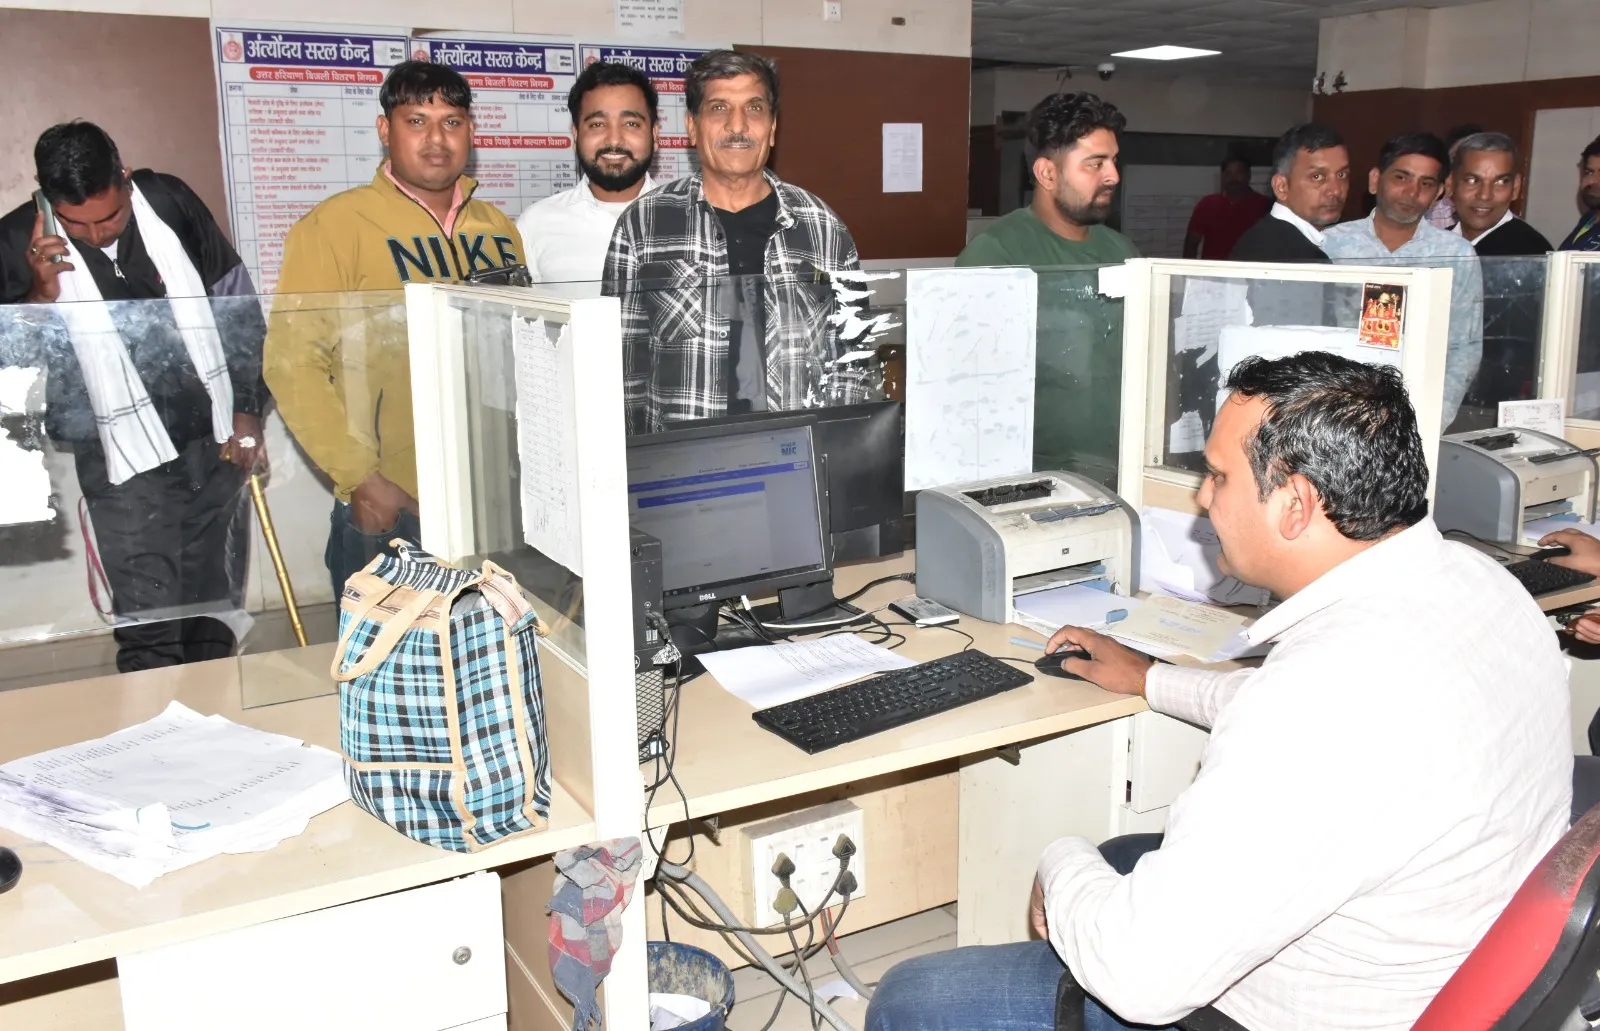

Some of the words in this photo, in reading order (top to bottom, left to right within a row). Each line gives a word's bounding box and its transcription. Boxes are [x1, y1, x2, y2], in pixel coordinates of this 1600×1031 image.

[304, 42, 338, 61] सरल
[340, 39, 370, 63] केन्द्र
[484, 50, 514, 68] सरल
[516, 48, 542, 70] केन्द्र
[648, 56, 674, 73] सरल
[256, 69, 273, 80] उत्तर
[274, 70, 304, 81] हरियाणा
[306, 70, 330, 82] बिजली
[332, 72, 356, 82] वितरण
[357, 73, 378, 83] निगम
[485, 78, 506, 88] बिजली
[508, 78, 529, 88] वितरण
[530, 78, 549, 88] निगम
[524, 138, 546, 147] कल्याण
[548, 136, 568, 147] विभाग
[386, 232, 518, 282] NIKE
